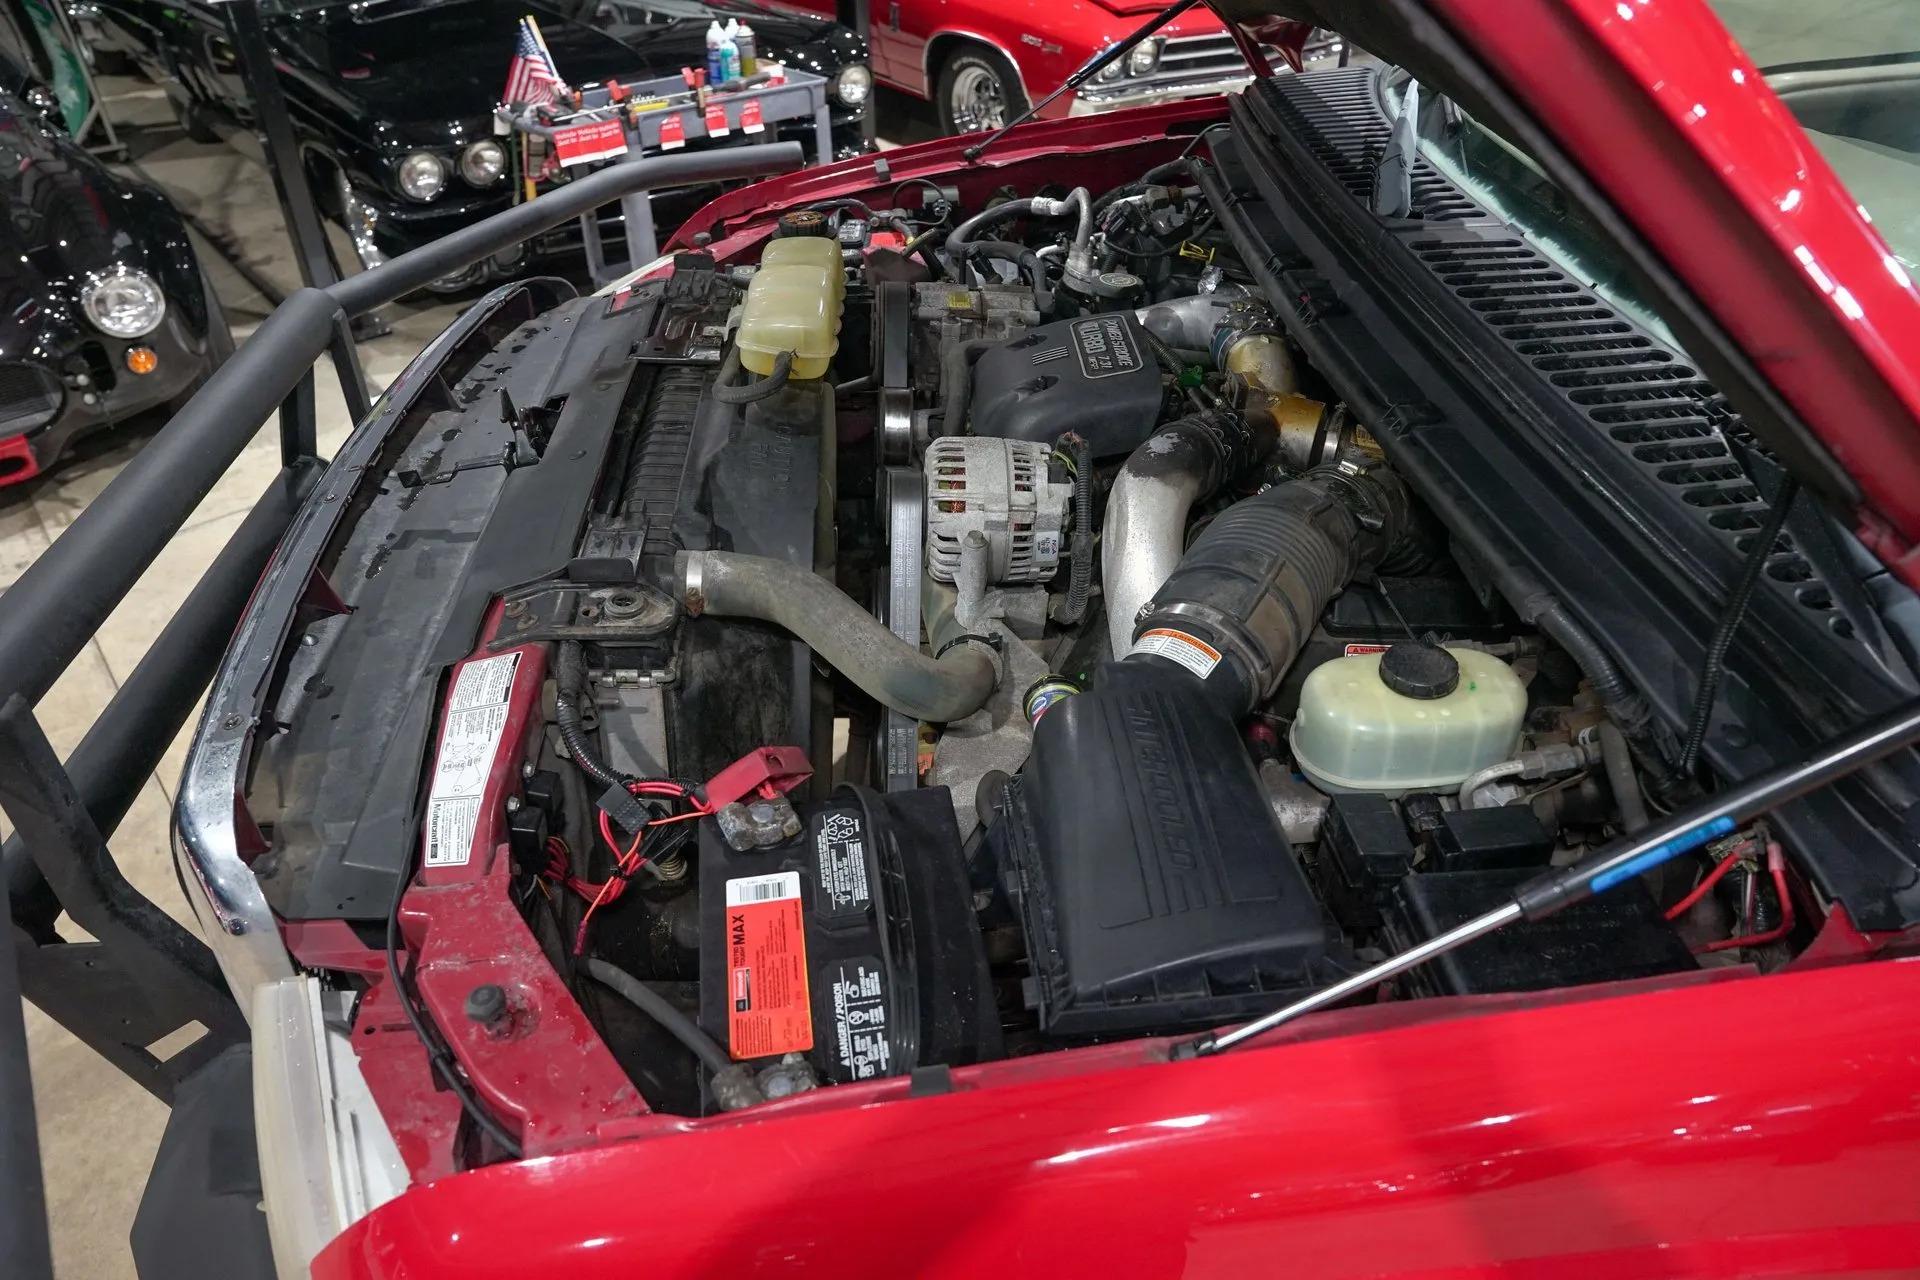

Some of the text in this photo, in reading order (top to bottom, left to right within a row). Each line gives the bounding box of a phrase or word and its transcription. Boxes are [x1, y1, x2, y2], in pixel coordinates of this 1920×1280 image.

[1078, 320, 1107, 354] TURBO
[733, 914, 745, 946] MAX
[837, 1021, 850, 1058] DANGER
